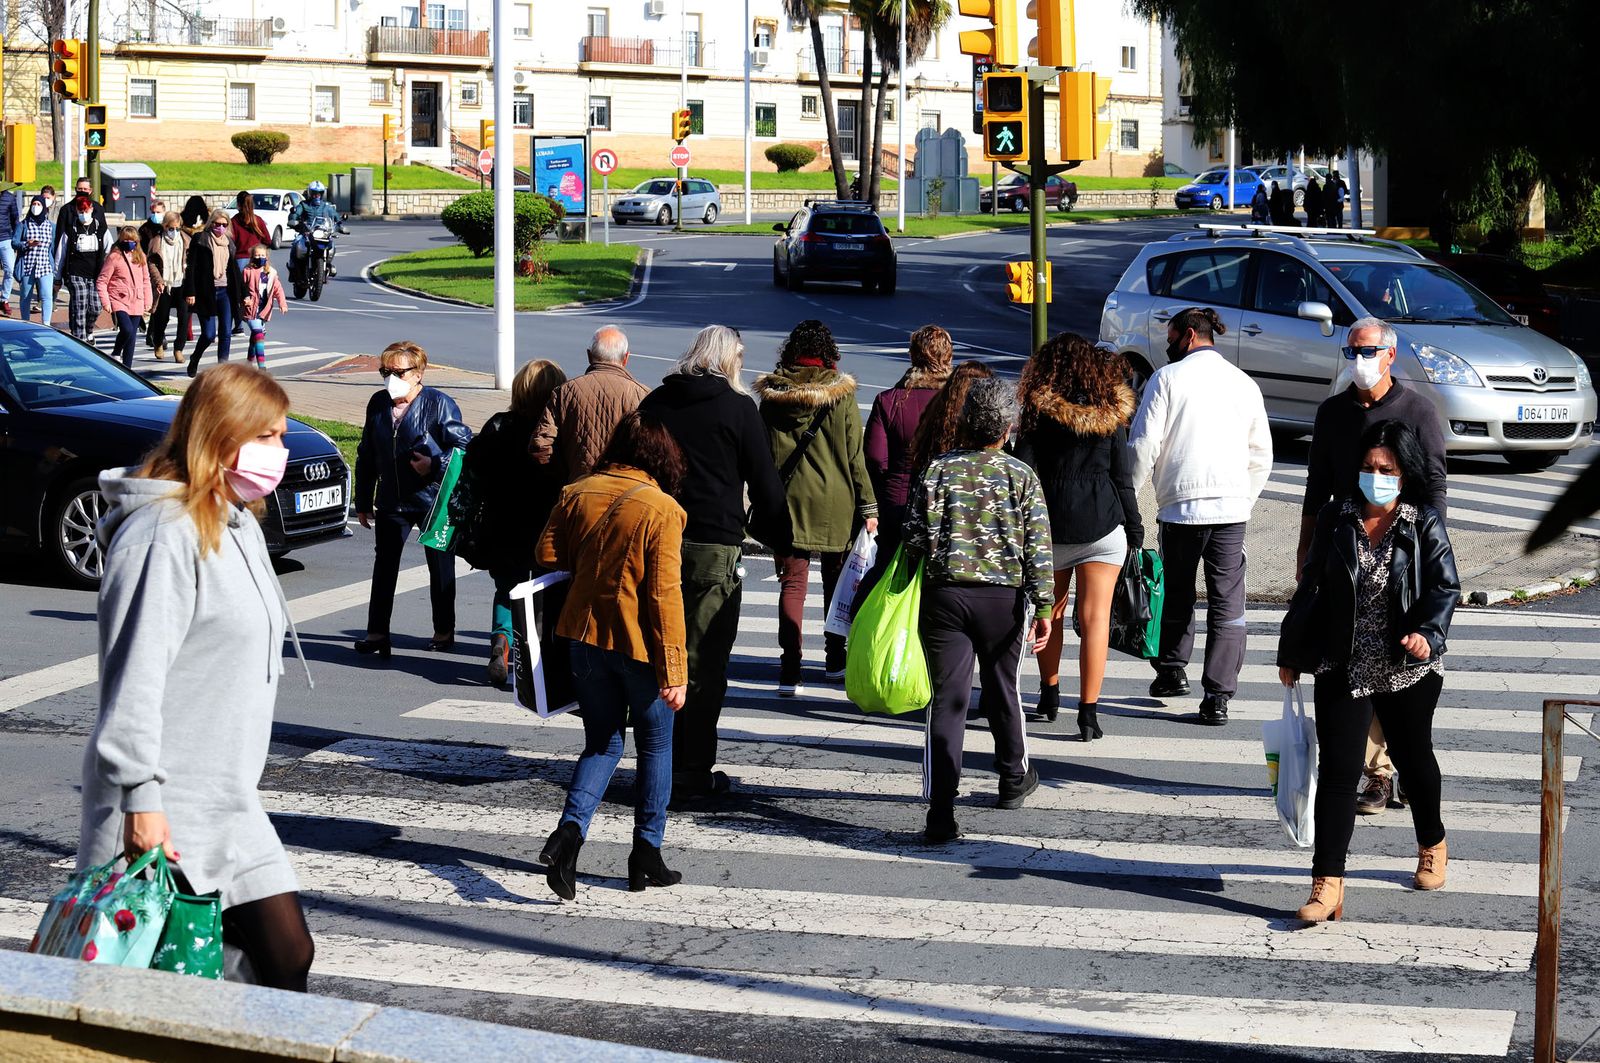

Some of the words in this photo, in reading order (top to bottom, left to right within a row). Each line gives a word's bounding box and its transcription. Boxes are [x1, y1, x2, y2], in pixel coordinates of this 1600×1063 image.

[1524, 408, 1548, 420] 0641
[1551, 408, 1568, 420] DVR
[302, 491, 323, 510] 7617
[327, 488, 340, 505] JWP
